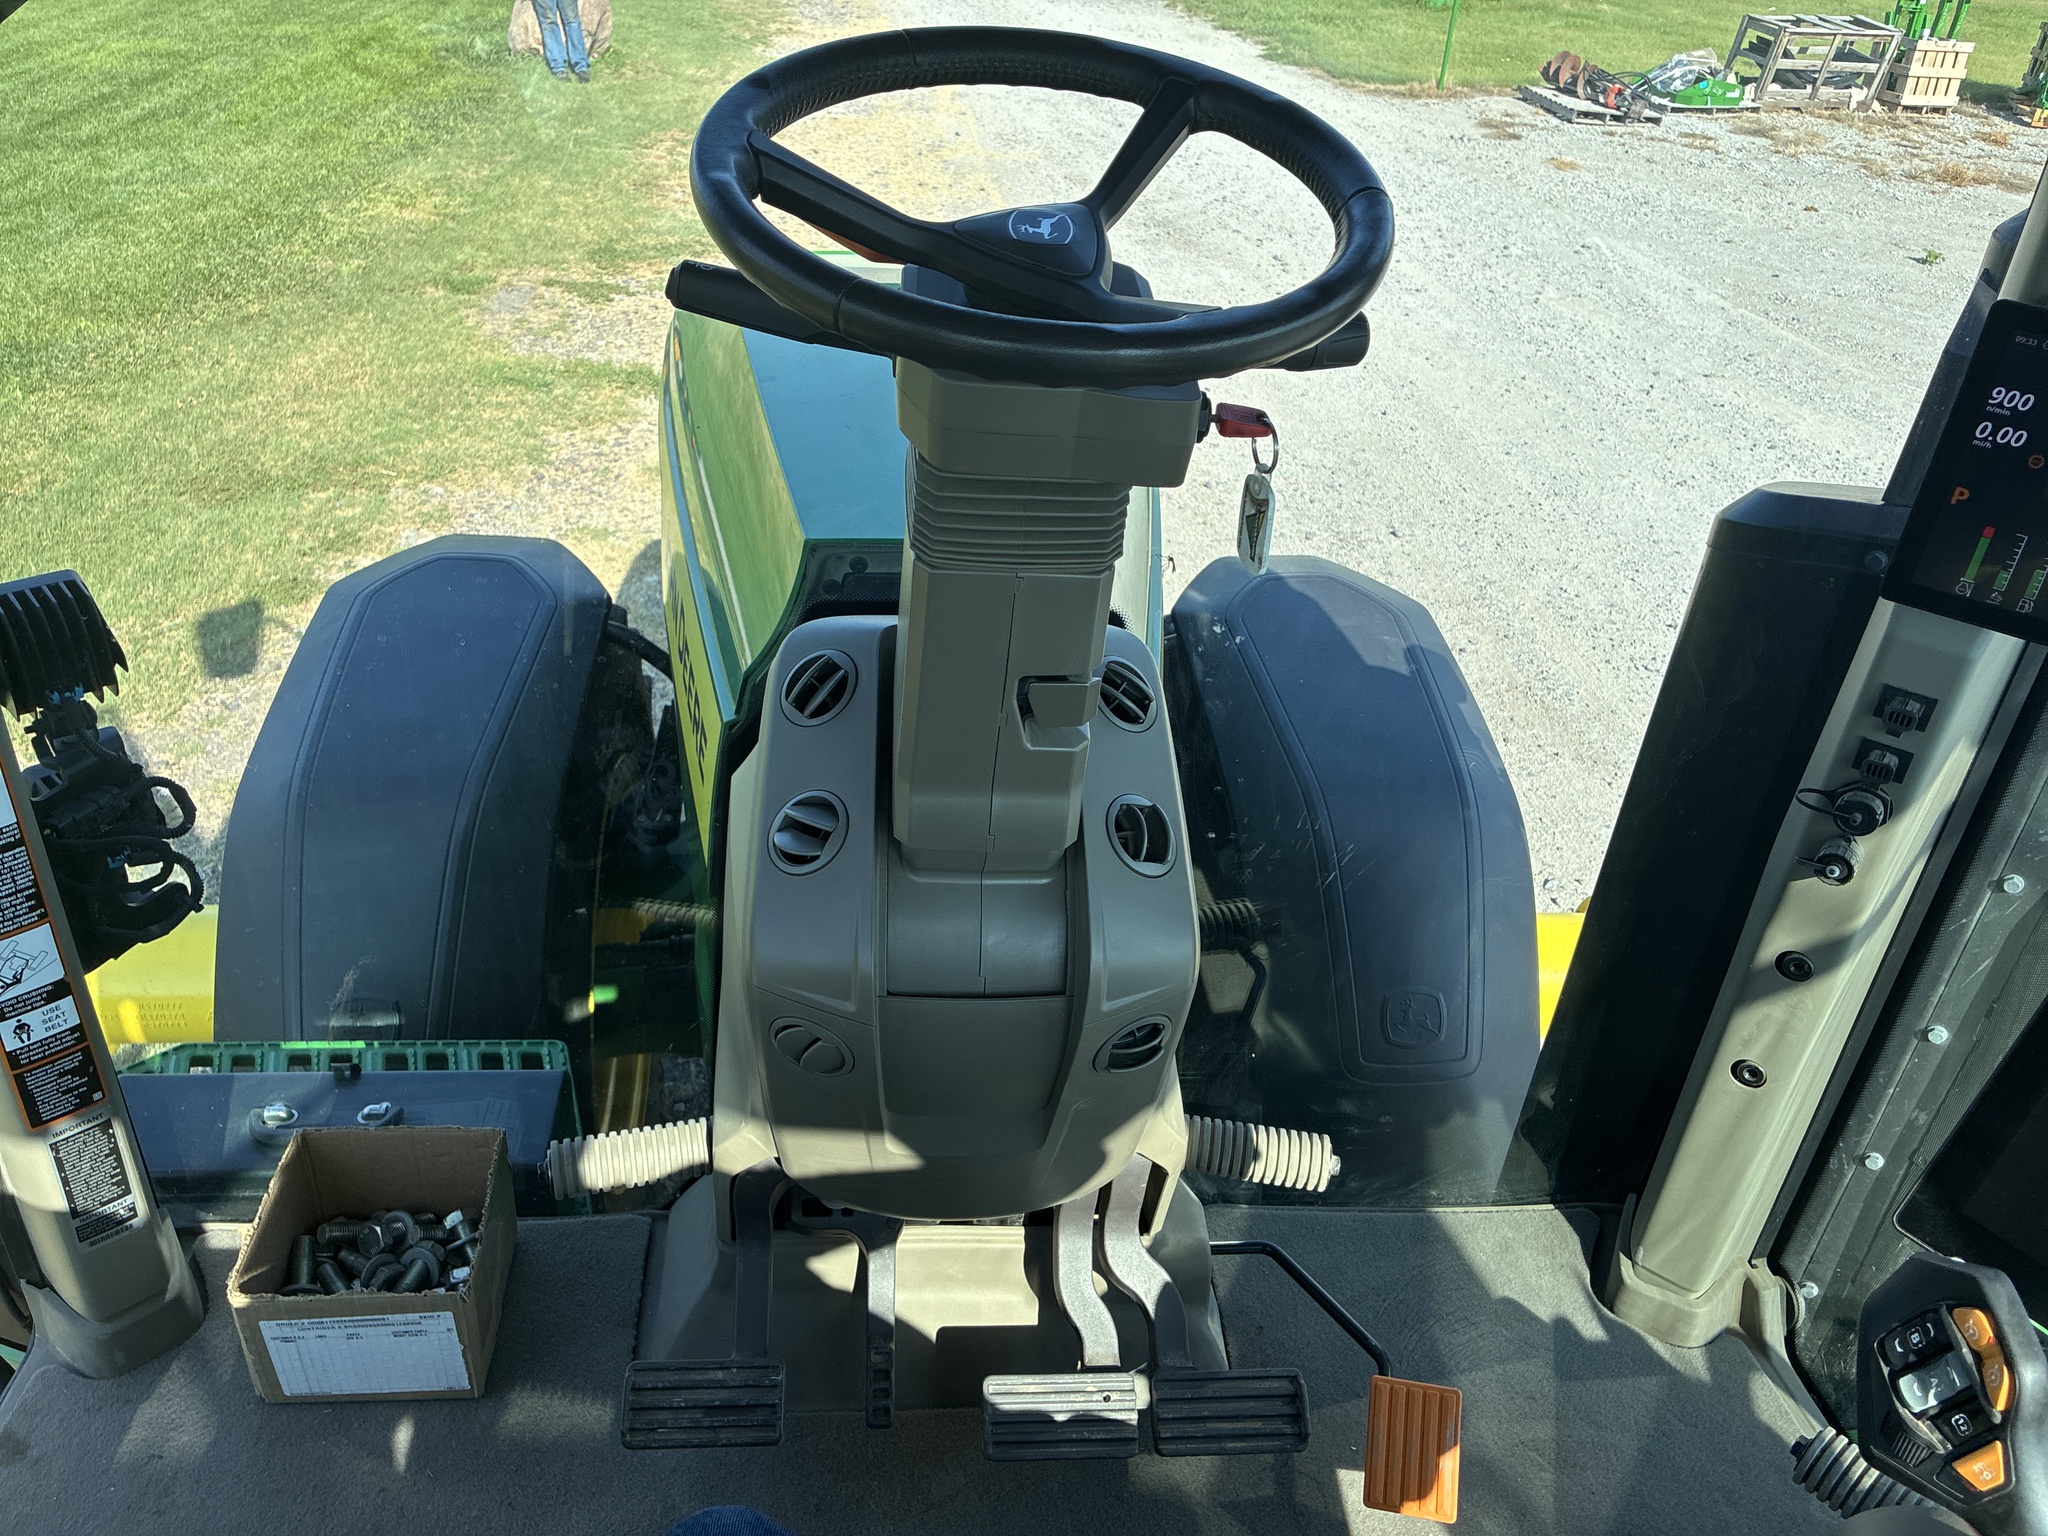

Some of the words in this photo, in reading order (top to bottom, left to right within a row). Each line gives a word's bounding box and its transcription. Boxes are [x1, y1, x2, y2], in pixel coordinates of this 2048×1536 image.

[1988, 387, 2035, 411] 900
[1986, 405, 2011, 416] n/min
[1975, 421, 2028, 447] 0.00
[1972, 439, 1992, 449] mi/h
[1950, 486, 1970, 505] P
[678, 597, 707, 788] DEERE
[18, 984, 54, 1001] CRUSHING:
[25, 995, 42, 1005] jump
[5, 1005, 32, 1018] machine
[33, 999, 46, 1008] tips.
[42, 1005, 62, 1016] USE
[41, 1011, 67, 1025] SEAT
[44, 1019, 69, 1032] BELT
[16, 1047, 29, 1055] Pull
[30, 1042, 41, 1050] belt
[42, 1037, 56, 1045] fully
[18, 1045, 48, 1059] retractors
[61, 1032, 80, 1043] adjust
[45, 1040, 77, 1055] protection.
[57, 1075, 72, 1083] ROPS
[39, 1105, 54, 1113] ROPS
[52, 1112, 104, 1138] IMPORTANT
[79, 1199, 128, 1223] IMPORTANT
[1957, 1418, 1968, 1431] 12
